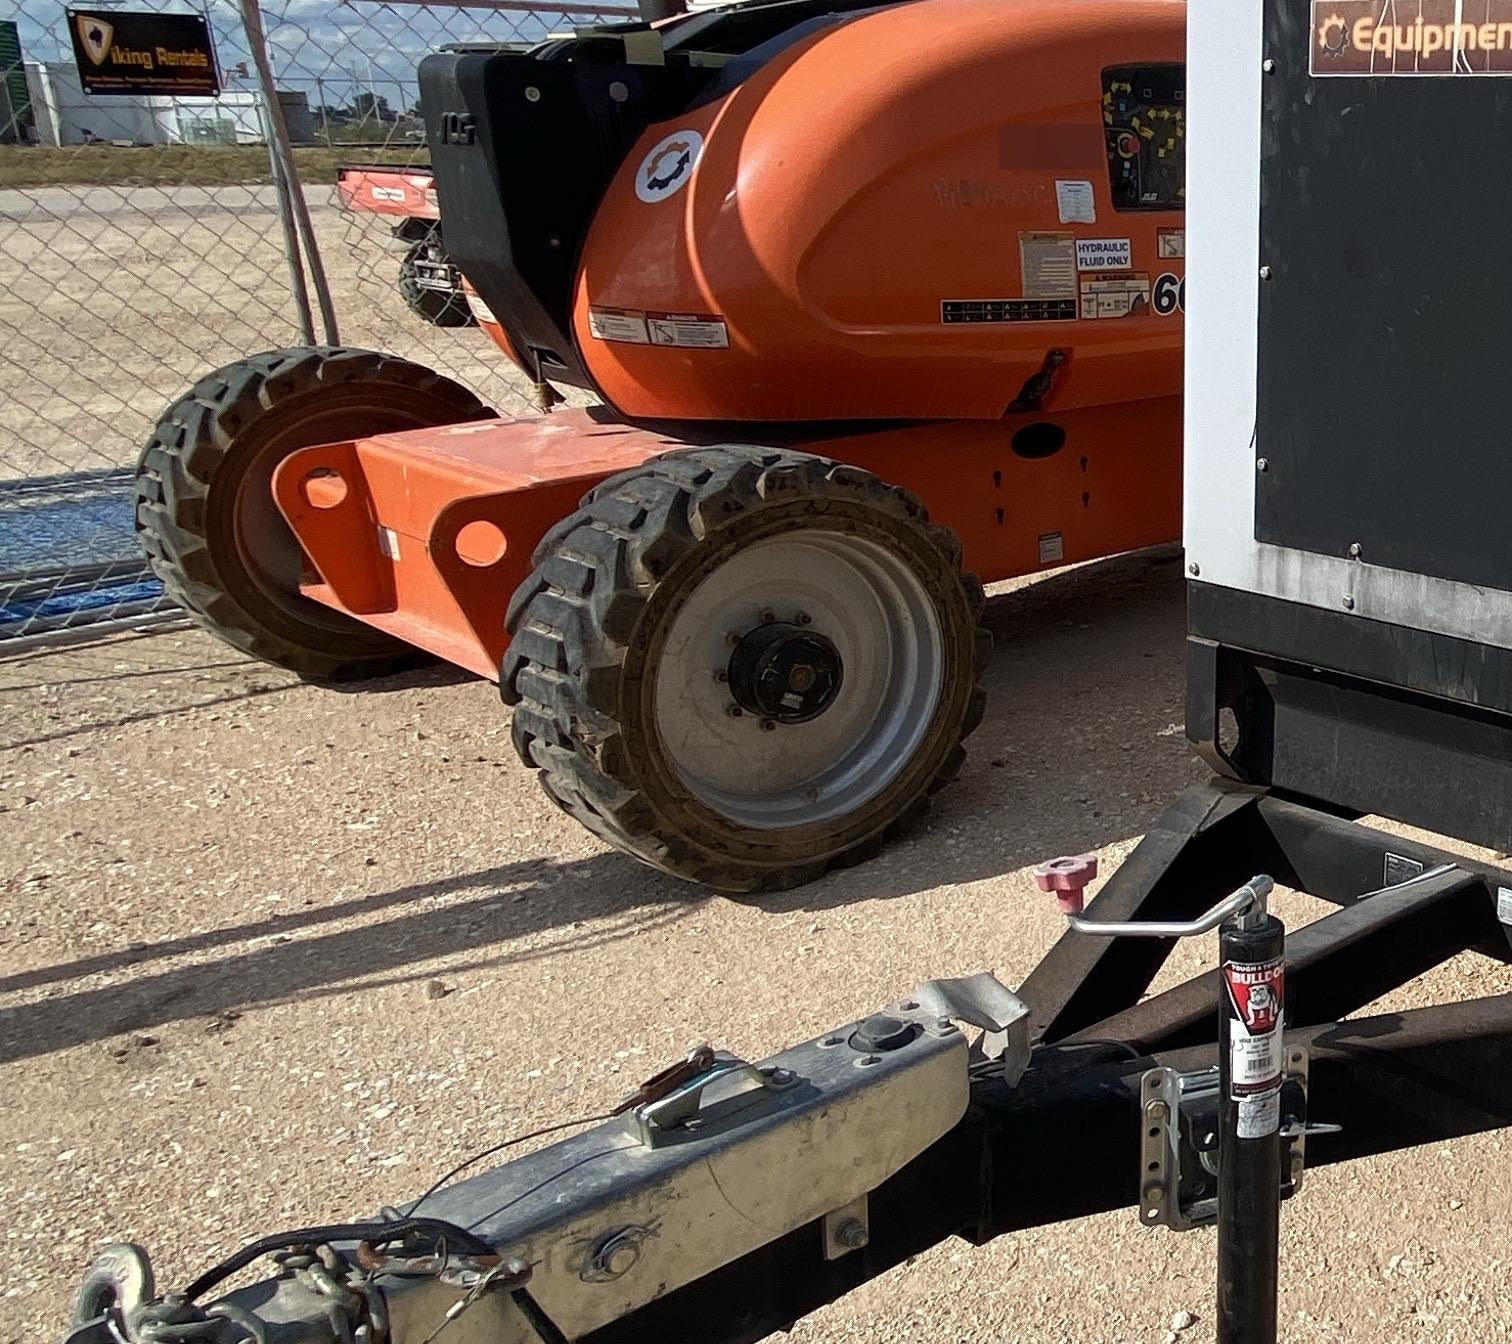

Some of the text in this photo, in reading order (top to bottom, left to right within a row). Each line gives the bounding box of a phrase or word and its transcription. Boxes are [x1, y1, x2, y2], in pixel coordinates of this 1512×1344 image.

[155, 47, 208, 67] Rentals
[1077, 242, 1129, 254] HYDRAULIC
[1079, 255, 1129, 267] FLUID ONLY
[1154, 273, 1185, 316] 6
